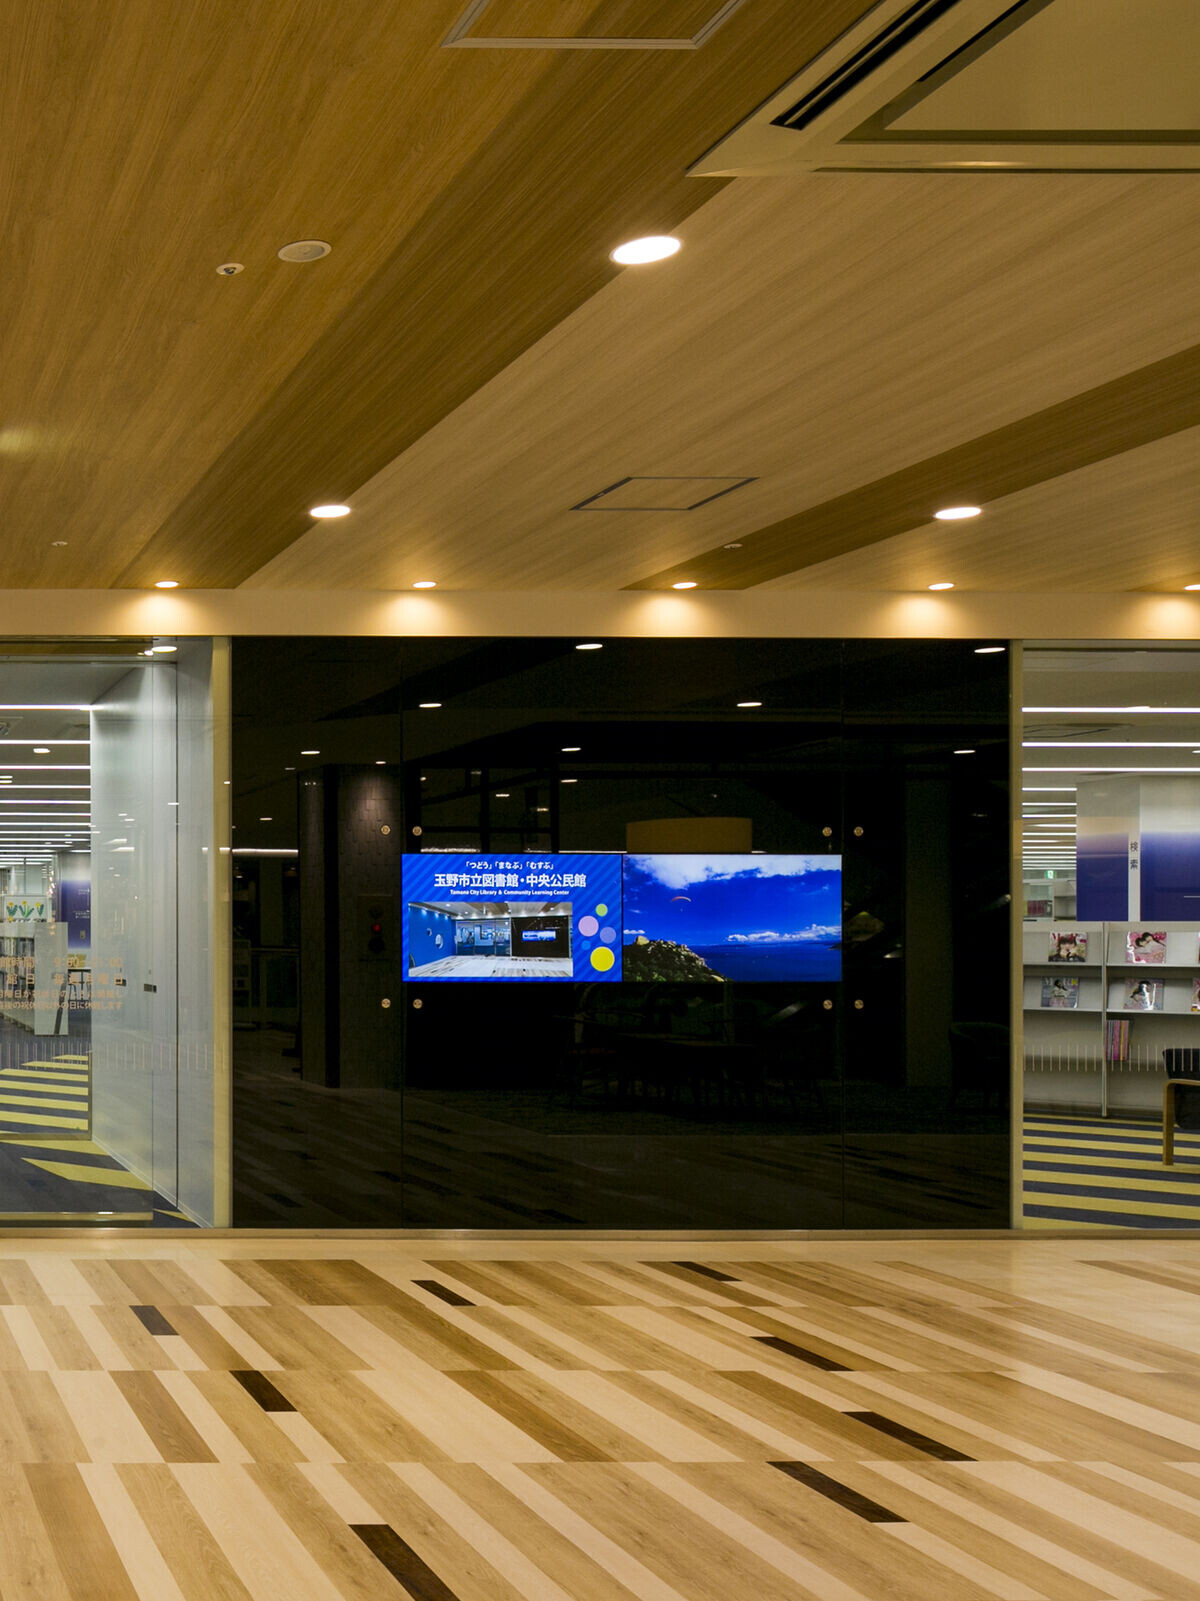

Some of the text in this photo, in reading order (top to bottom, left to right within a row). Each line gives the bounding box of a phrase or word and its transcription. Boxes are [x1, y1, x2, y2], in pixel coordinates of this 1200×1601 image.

[434, 873, 587, 888] 玉野市立図書館・中央公民館
[470, 889, 479, 897] City
[480, 889, 497, 897] Library
[504, 889, 531, 897] Community
[532, 889, 552, 897] Learning
